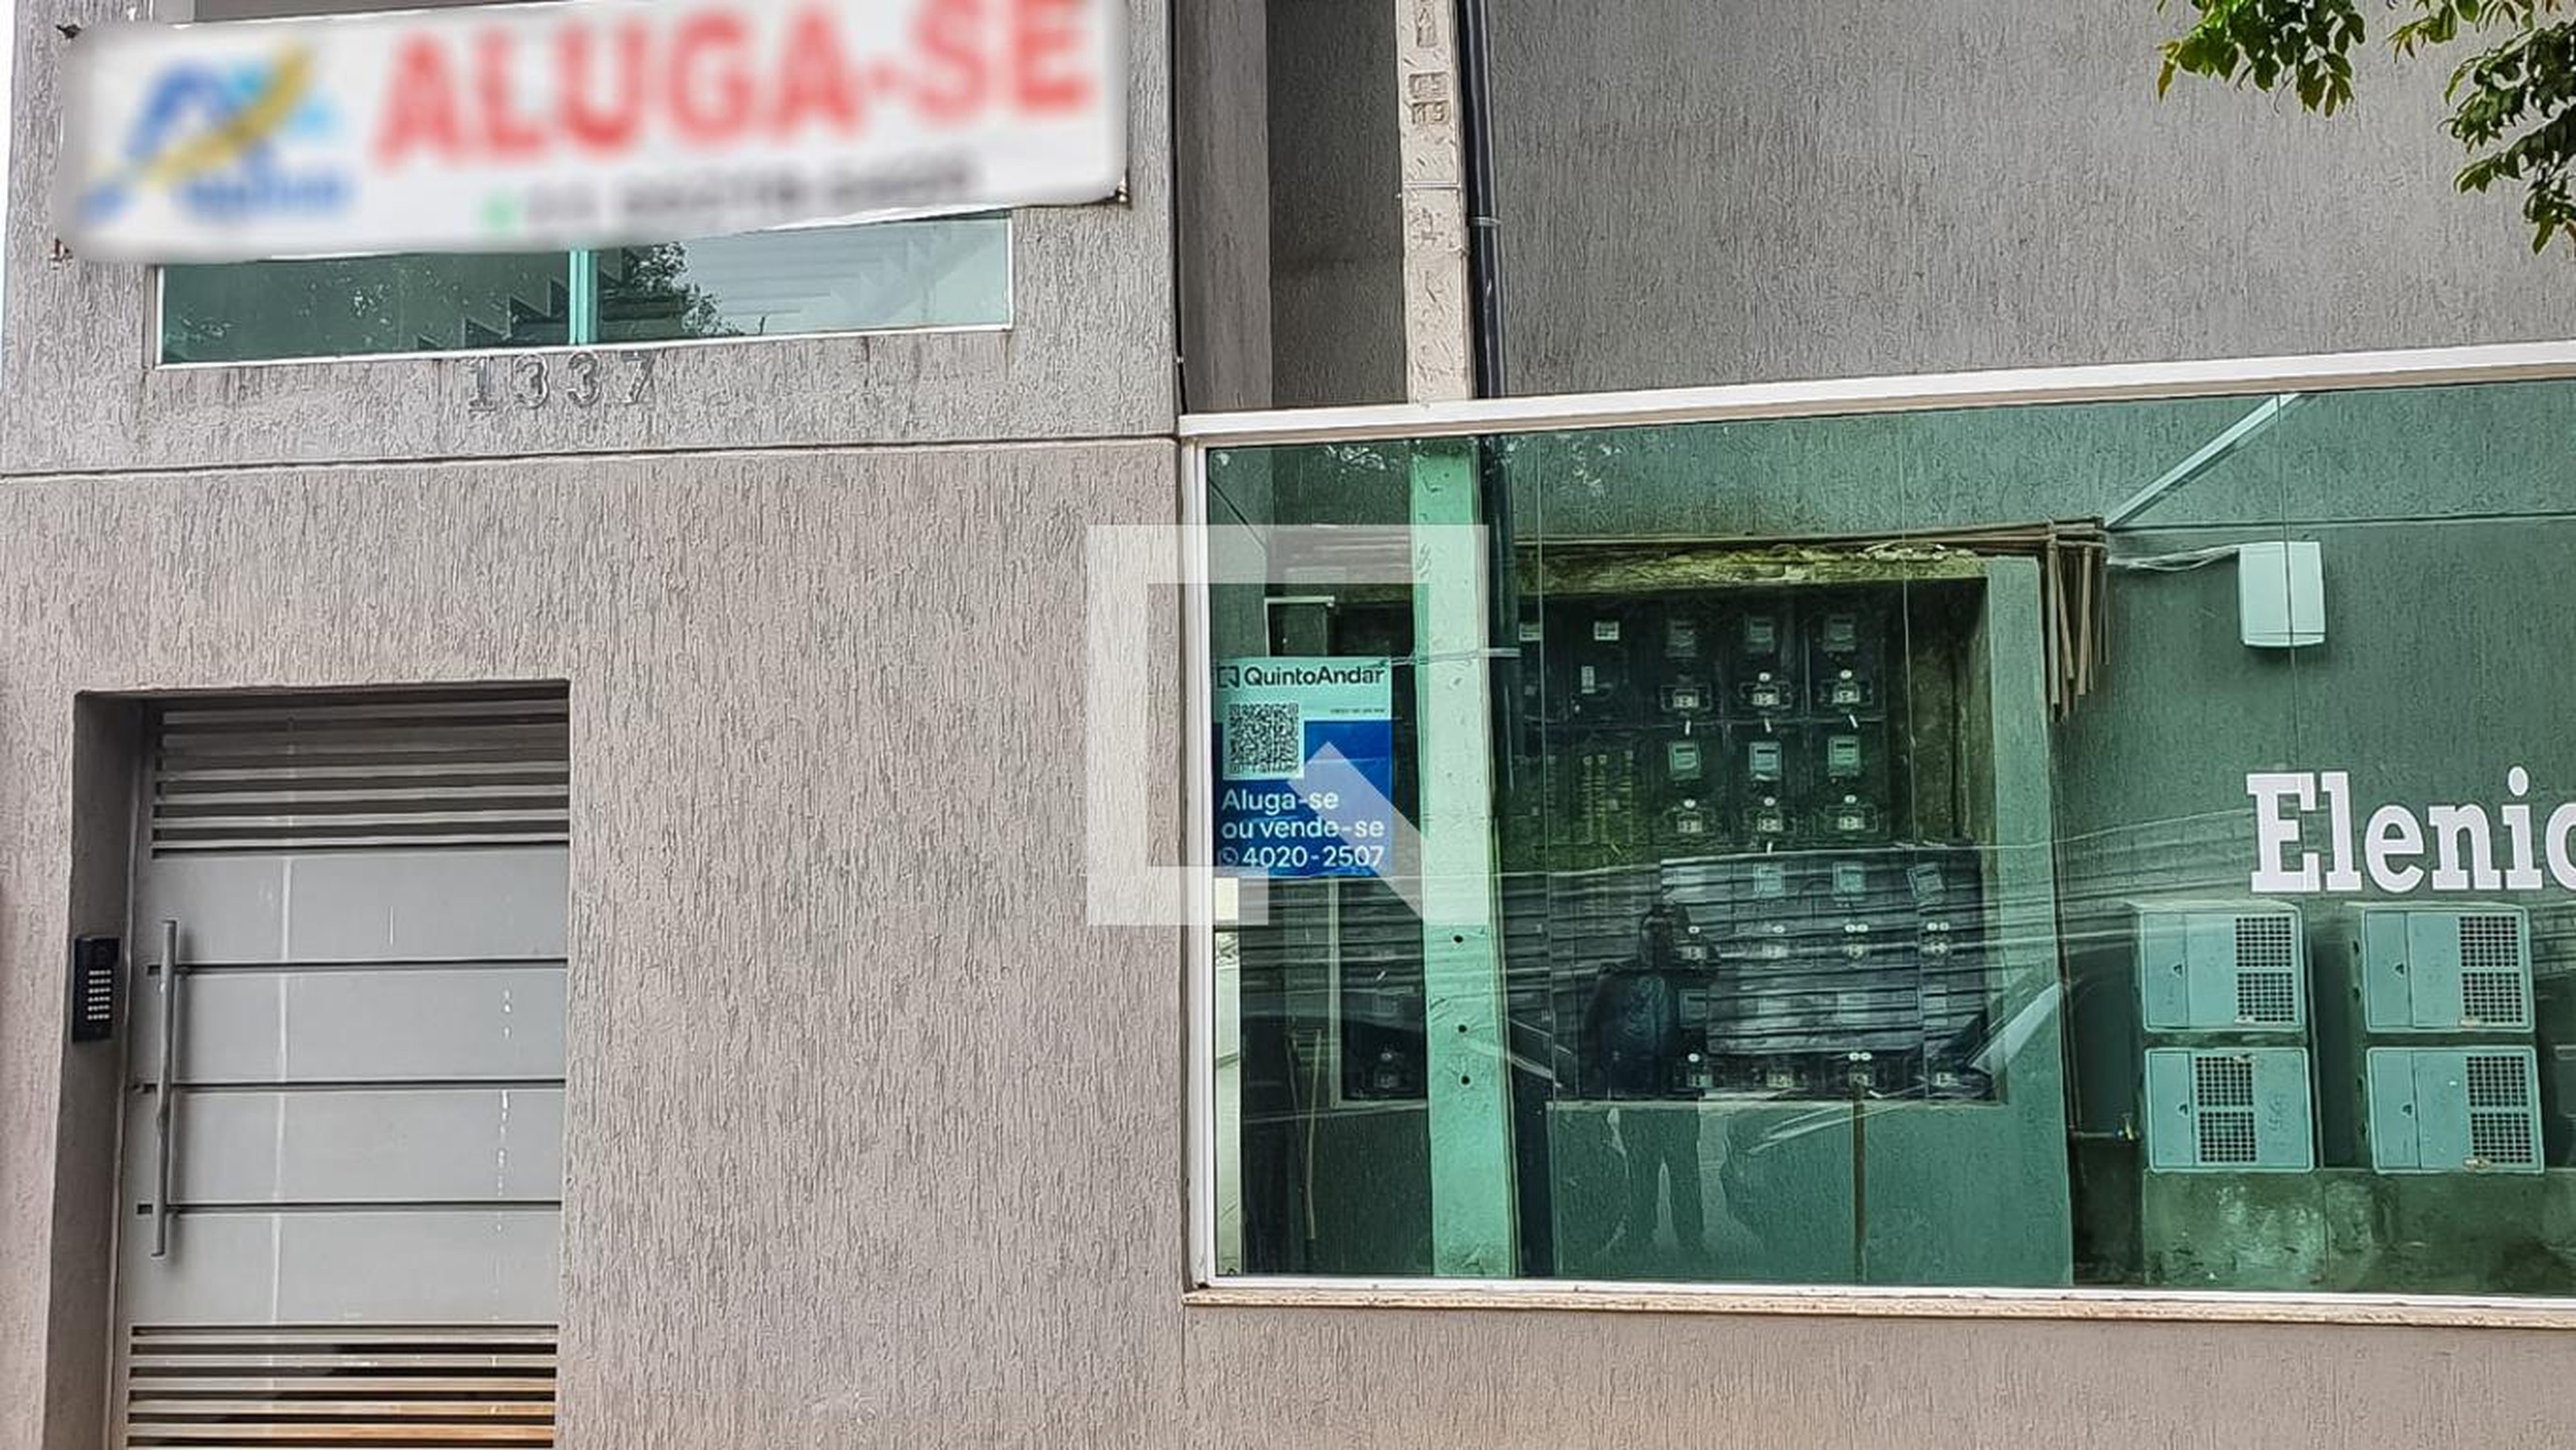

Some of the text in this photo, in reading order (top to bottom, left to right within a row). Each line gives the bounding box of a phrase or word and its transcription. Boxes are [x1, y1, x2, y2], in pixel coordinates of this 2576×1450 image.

[372, 0, 1100, 171] ALUGA-SE
[468, 350, 655, 411] 1337
[1244, 666, 1385, 686] QuintoAndar
[1222, 788, 1338, 815] Aluga-se
[1222, 816, 1385, 839] ou vende-se
[1242, 845, 1384, 868] 4020-2507
